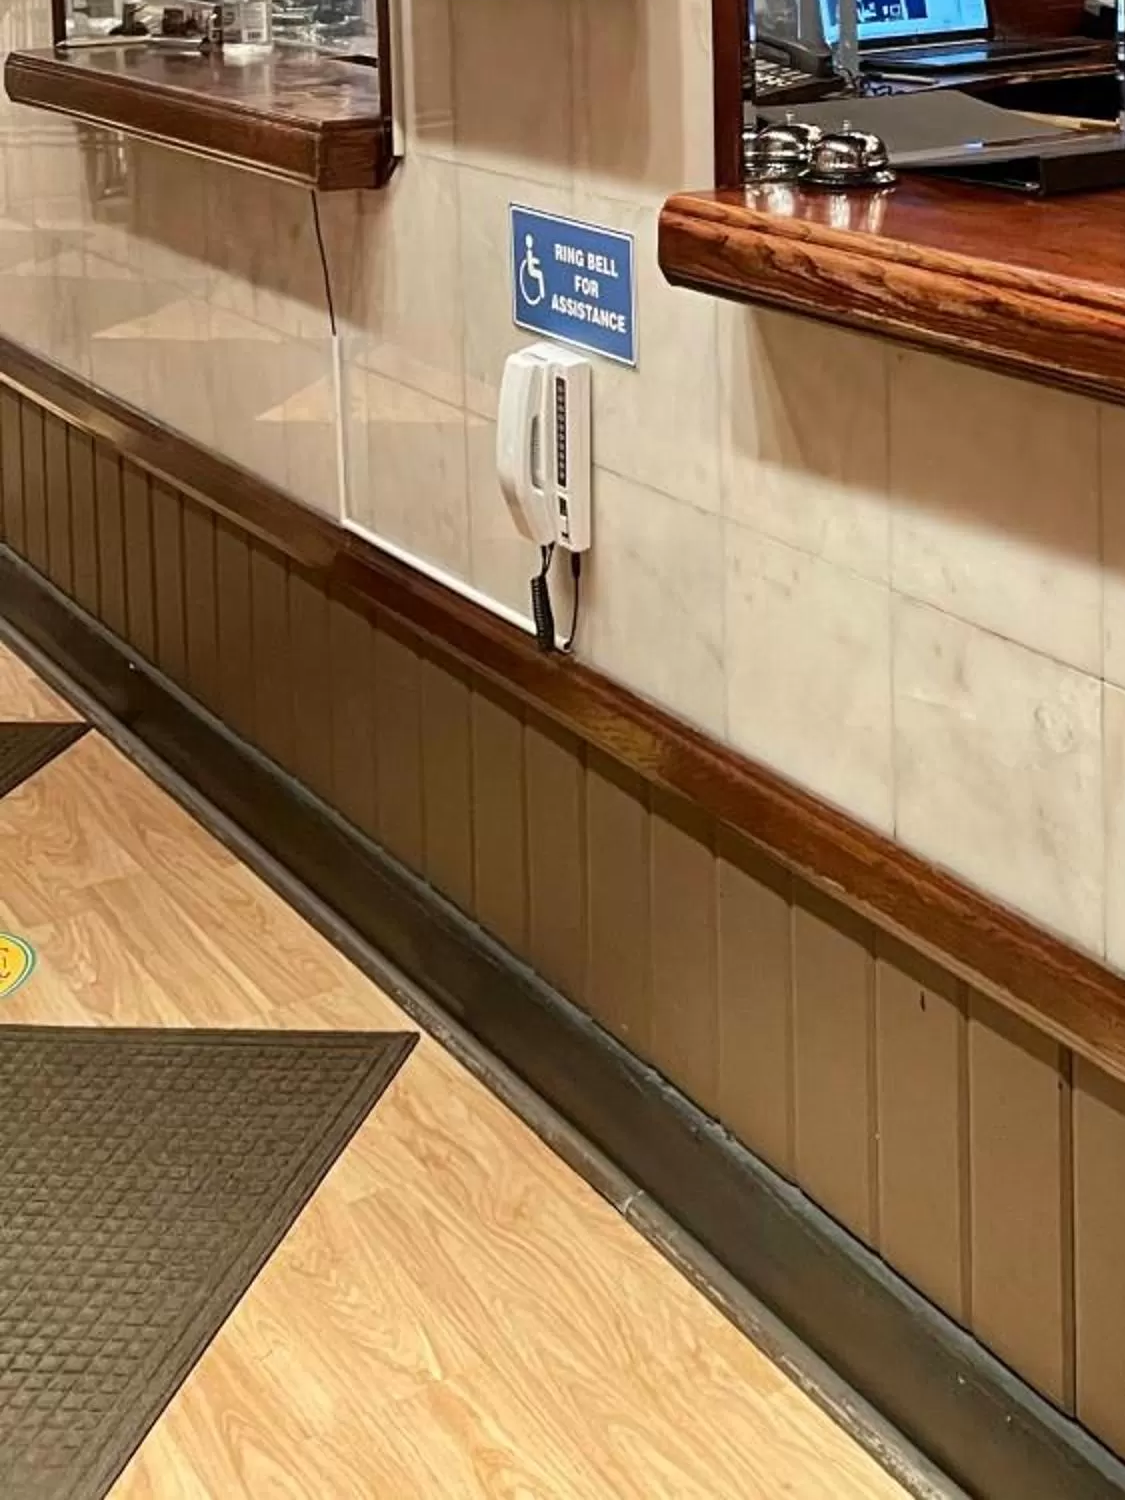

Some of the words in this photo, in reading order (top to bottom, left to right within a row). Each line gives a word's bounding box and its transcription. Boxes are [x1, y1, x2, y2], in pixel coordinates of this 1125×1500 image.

[554, 243, 584, 267] RING
[587, 252, 619, 277] BELL
[574, 275, 599, 299] FOR
[551, 293, 627, 334] ASSISTANCE
